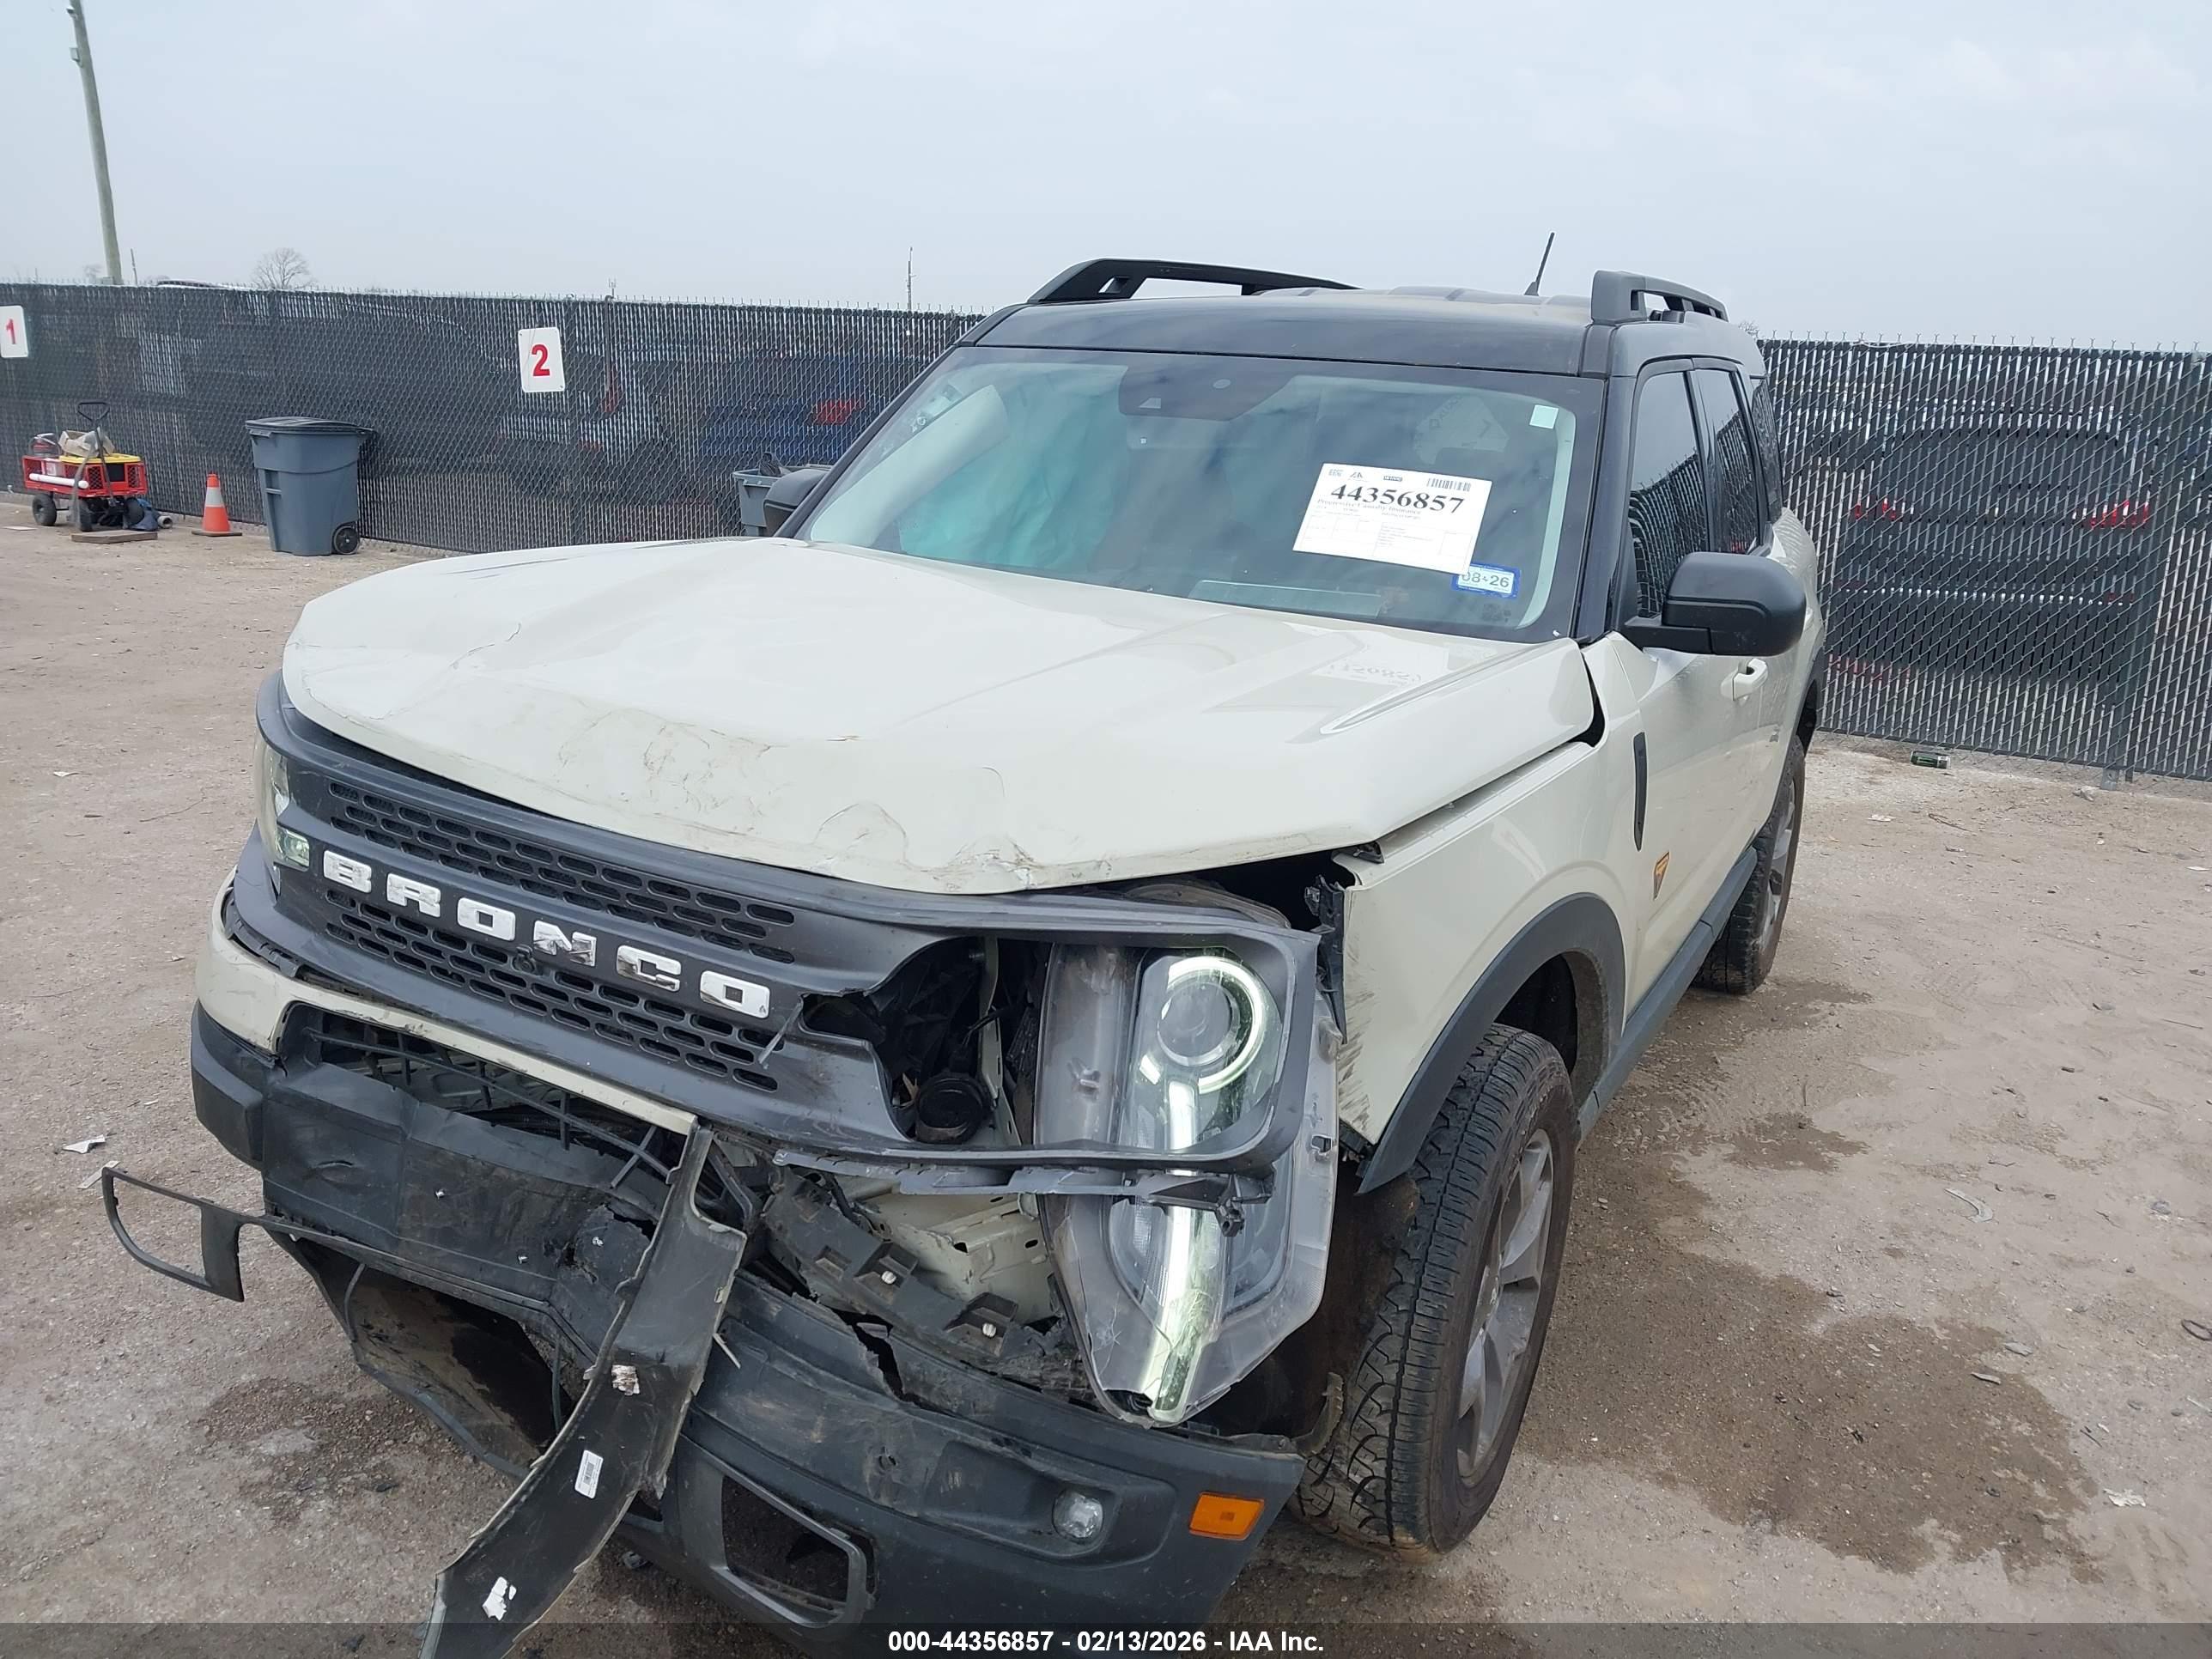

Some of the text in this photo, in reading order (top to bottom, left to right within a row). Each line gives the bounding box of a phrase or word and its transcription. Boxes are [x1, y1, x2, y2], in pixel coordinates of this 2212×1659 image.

[6, 319, 16, 344] 1
[532, 344, 550, 376] 2
[1331, 484, 1464, 514] 44356857
[1490, 574, 1510, 588] 26
[323, 849, 770, 1018] BRONCO
